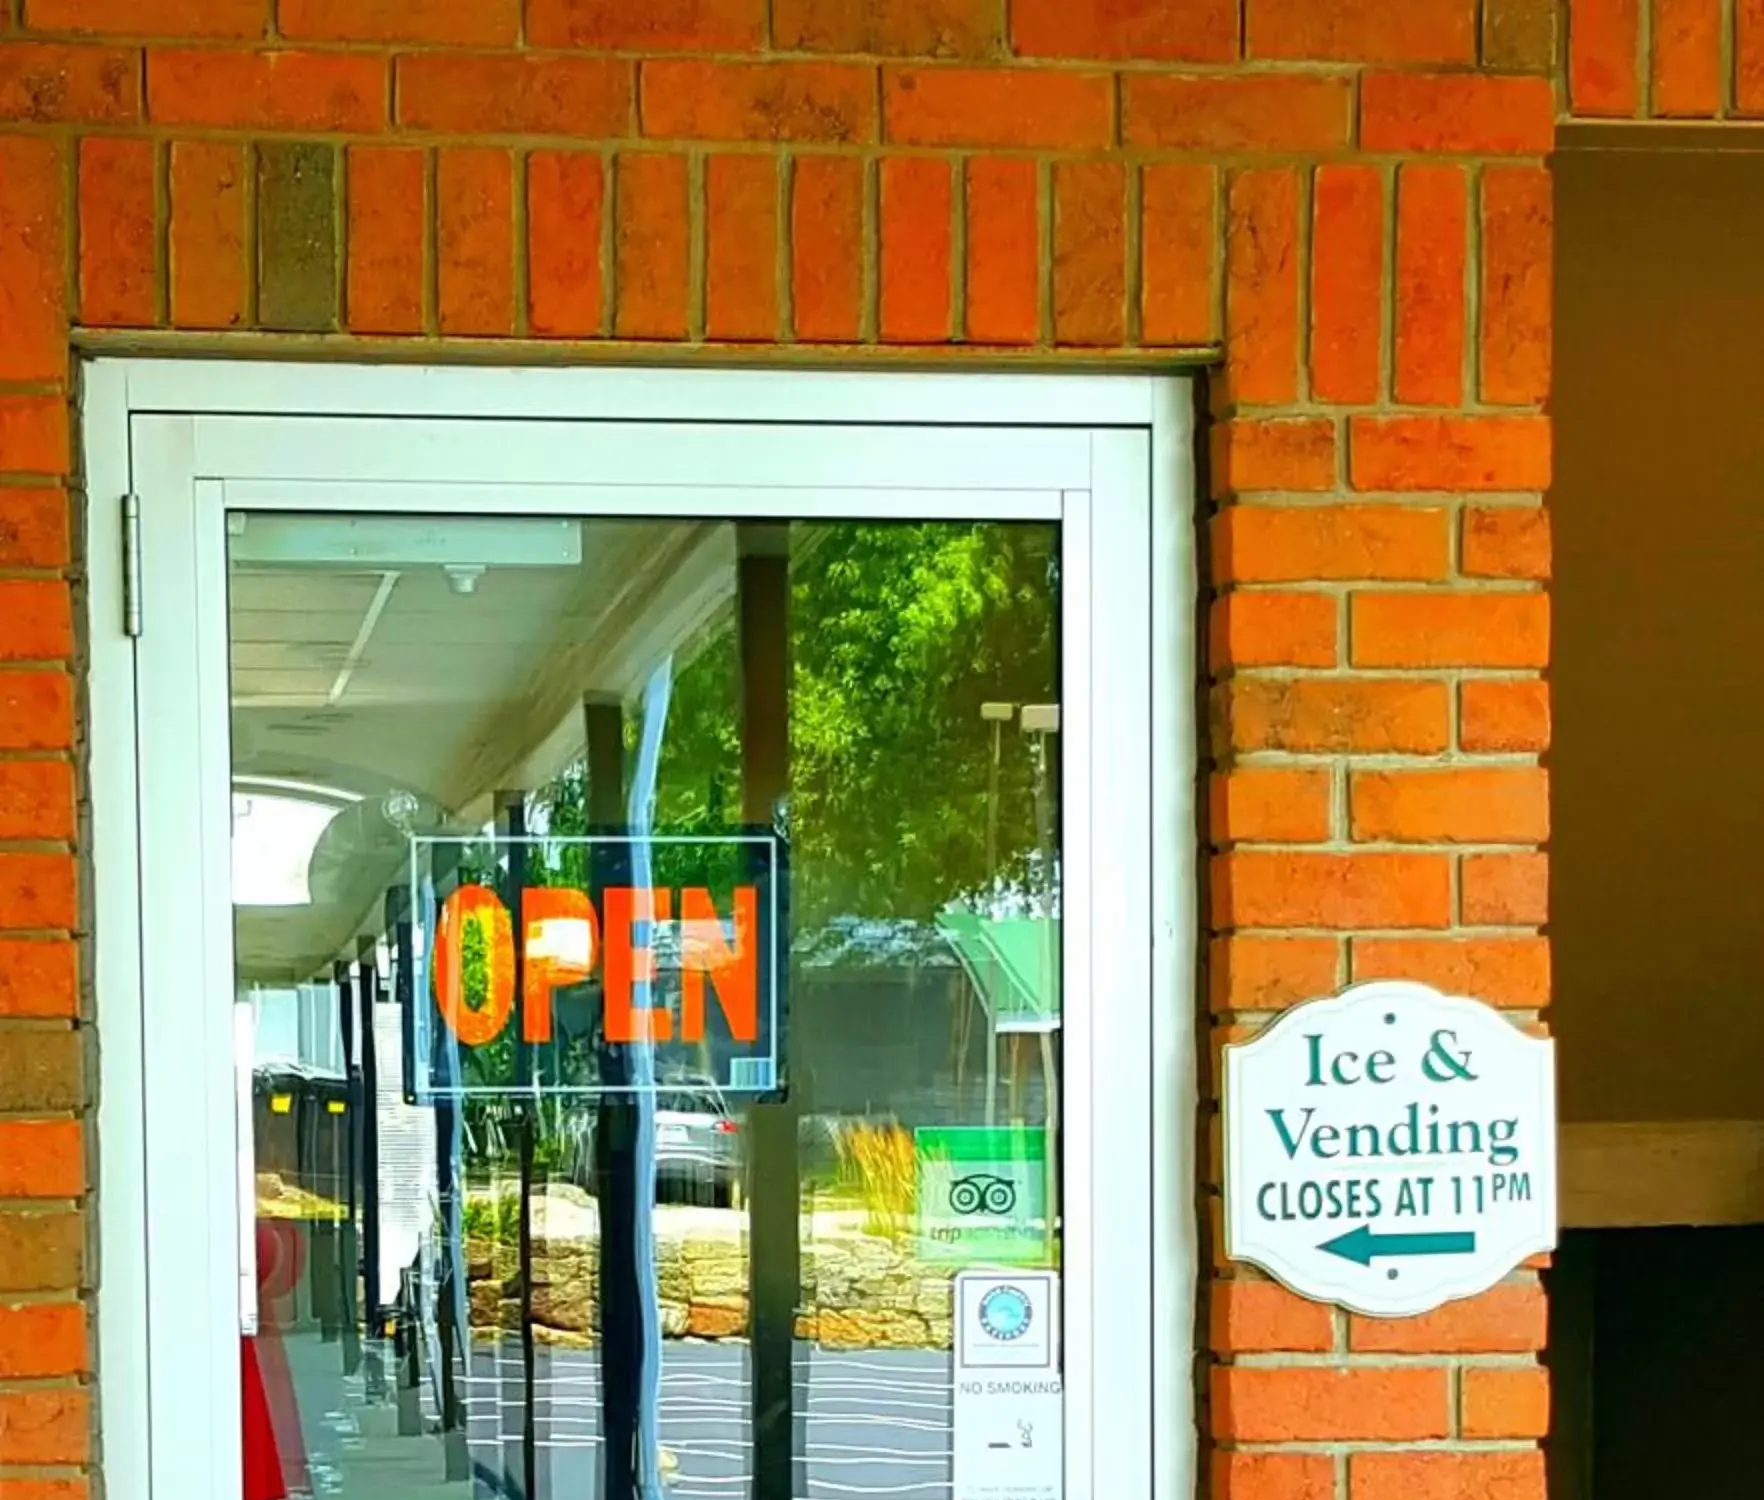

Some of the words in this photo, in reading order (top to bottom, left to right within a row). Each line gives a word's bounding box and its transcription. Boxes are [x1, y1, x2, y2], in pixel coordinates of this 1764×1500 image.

[434, 883, 757, 1044] OPEN
[1304, 1034, 1396, 1086] Ice
[1421, 1029, 1479, 1082] &
[1264, 1102, 1519, 1167] Vending
[1257, 1179, 1381, 1221] CLOSES
[1395, 1177, 1434, 1217] AT
[960, 1381, 982, 1395] NO
[987, 1381, 1062, 1394] SMOKING
